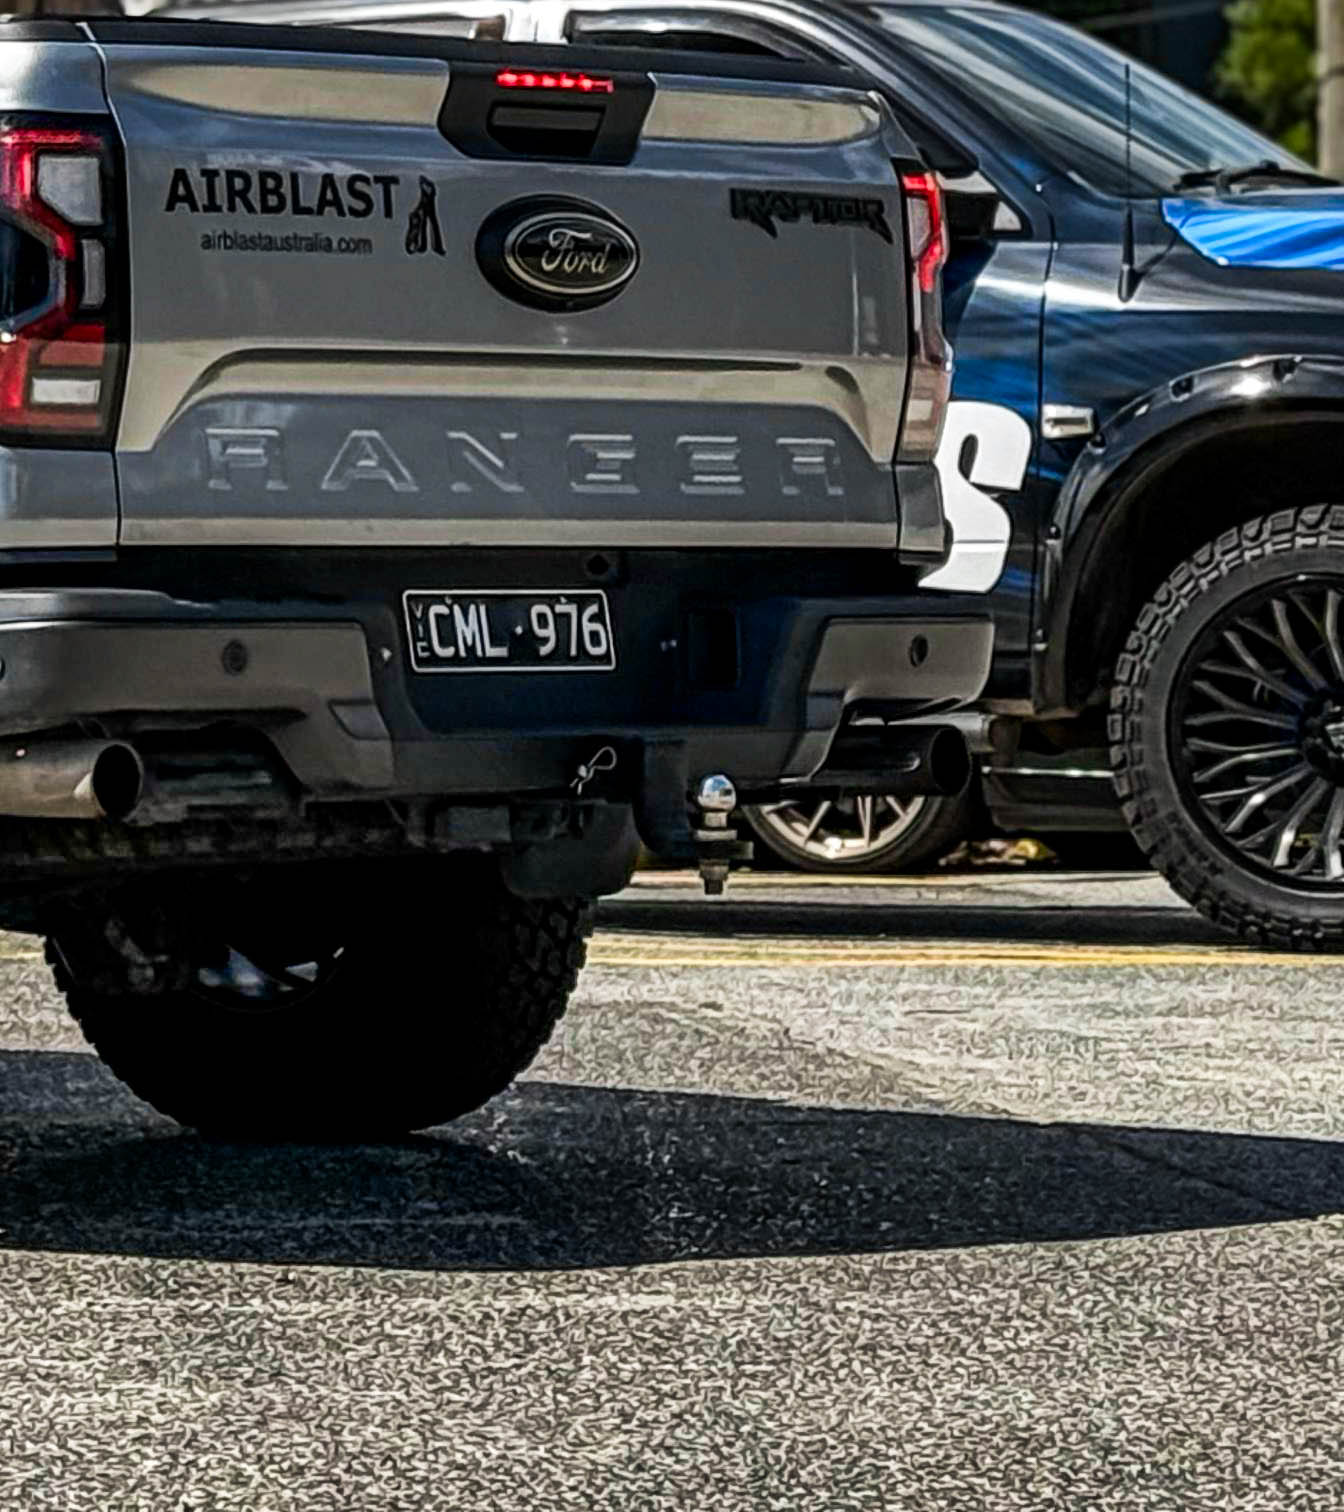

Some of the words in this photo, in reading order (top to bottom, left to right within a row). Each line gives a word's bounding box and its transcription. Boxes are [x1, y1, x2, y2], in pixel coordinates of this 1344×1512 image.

[165, 168, 400, 219] AIRBLAST
[730, 188, 893, 245] RAPTOR
[200, 229, 373, 255] airblastaustralia.com
[541, 228, 610, 275] Ford
[206, 428, 844, 495] RANGER
[428, 603, 509, 658] CML
[530, 603, 608, 657] 976
